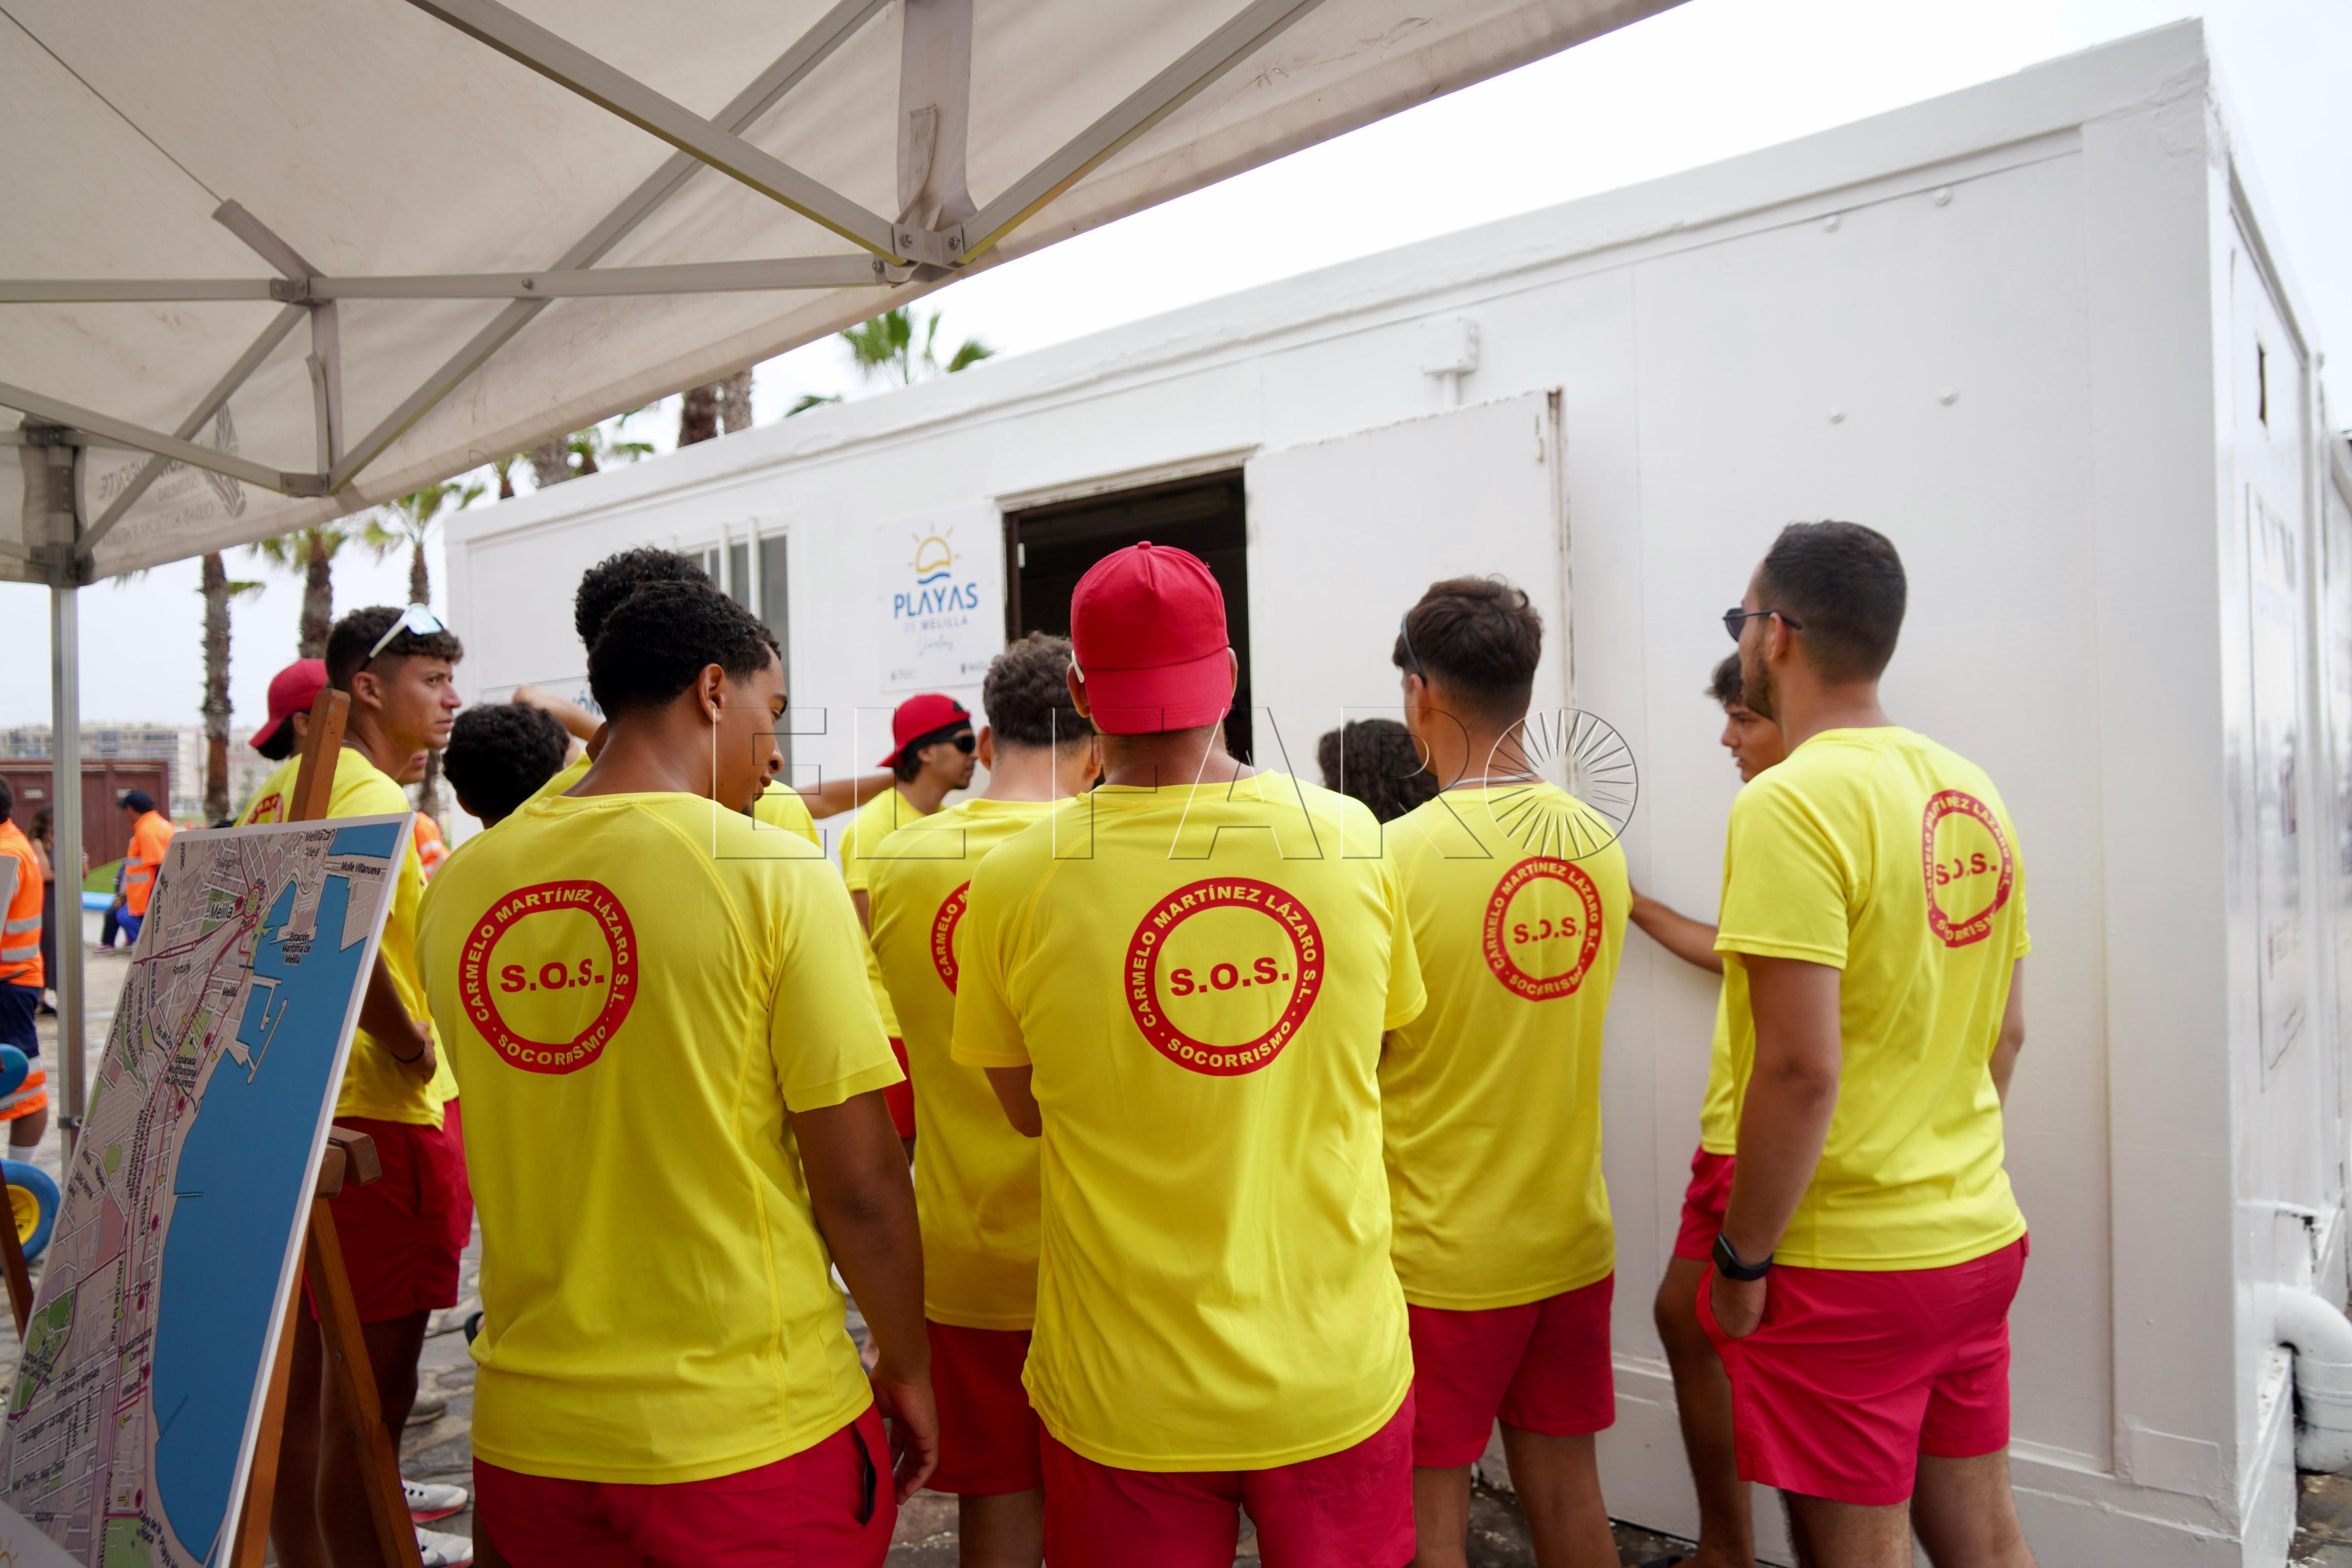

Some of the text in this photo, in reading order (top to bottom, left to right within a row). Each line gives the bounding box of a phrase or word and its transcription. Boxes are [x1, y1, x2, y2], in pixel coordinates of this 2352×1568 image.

[894, 582, 978, 618] PLAYAS
[305, 830, 322, 842] Melilla
[306, 846, 320, 859] Vieja
[340, 862, 381, 875] Mulle Villanueva
[209, 902, 233, 919] Melilla
[1487, 897, 1505, 969] CARMELO
[1500, 860, 1567, 896] MARTÍNEZ
[1567, 871, 1600, 923] LÁZARO
[289, 931, 310, 942] Estación
[304, 944, 311, 953] de
[466, 887, 629, 1022] CARMELO MARTÍNEZ LÁZARO S.L.
[936, 903, 958, 976] CARMELO
[284, 954, 301, 964] Melilla
[1132, 885, 1317, 1027] CARMELO MARTÍNEZ LÁZARO S.L.
[500, 958, 605, 993] S.O.S.
[1170, 957, 1290, 996] S.O.S.
[498, 1025, 606, 1066] SOCORRISMO
[1167, 1021, 1291, 1068] SOCORRISMO
[126, 1109, 144, 1188] Monumental
[141, 1185, 151, 1226] Carlos
